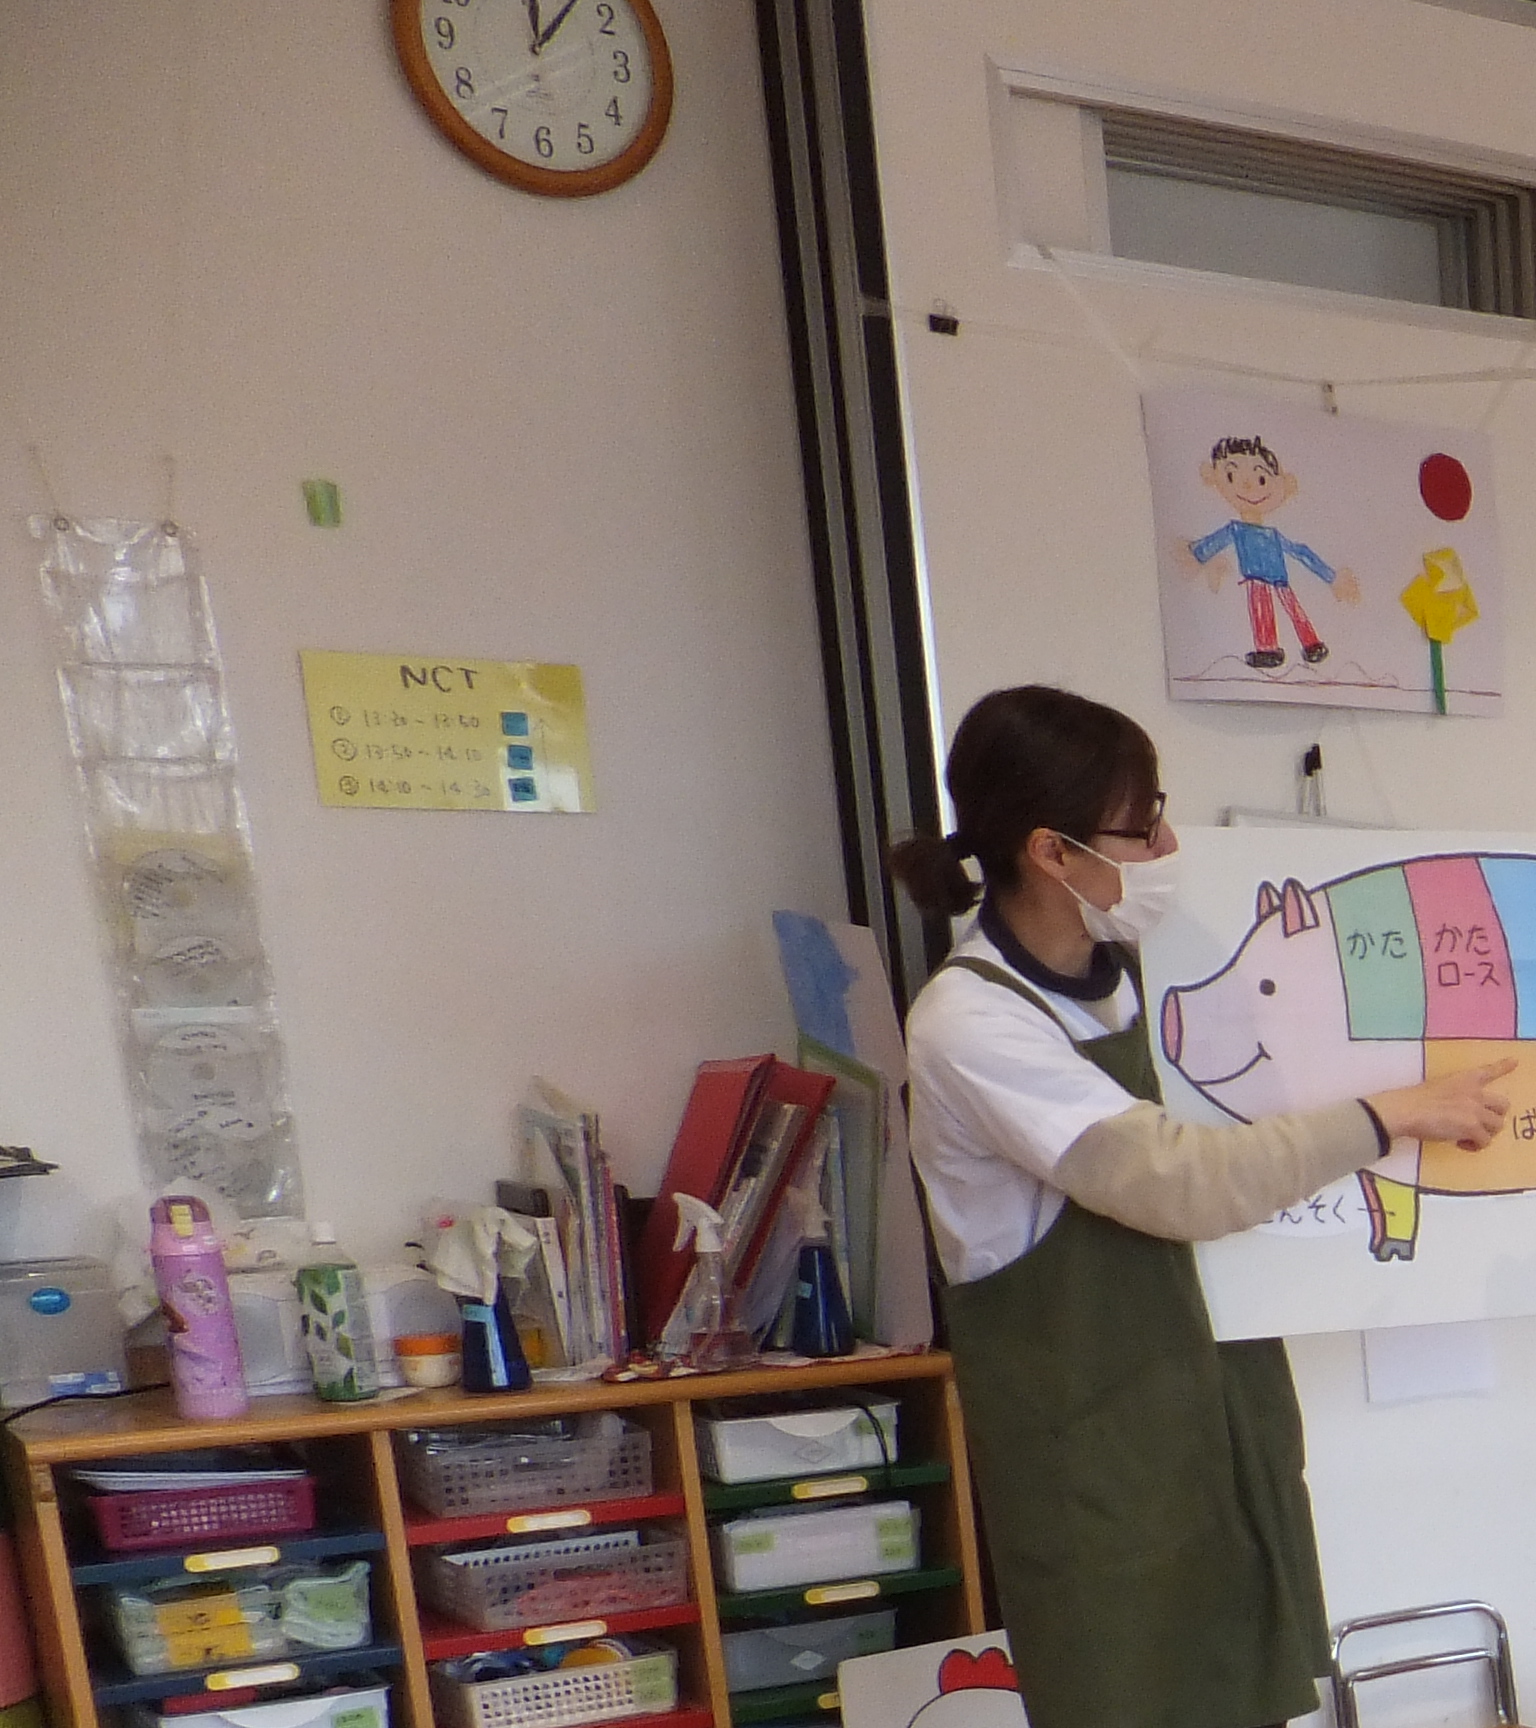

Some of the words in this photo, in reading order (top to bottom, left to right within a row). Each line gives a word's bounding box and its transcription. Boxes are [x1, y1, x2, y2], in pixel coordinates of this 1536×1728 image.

[434, 17, 455, 50] 9
[596, 3, 616, 36] 2
[455, 66, 474, 100] 8
[612, 50, 631, 84] 3
[491, 107, 508, 140] 7
[604, 95, 623, 127] 4
[534, 126, 554, 158] 6
[576, 122, 595, 155] 5
[400, 664, 478, 692] NCT
[1347, 928, 1407, 960] かた
[1434, 923, 1491, 956] かた
[1437, 962, 1500, 987] ロース
[1262, 1195, 1345, 1224] んそく
